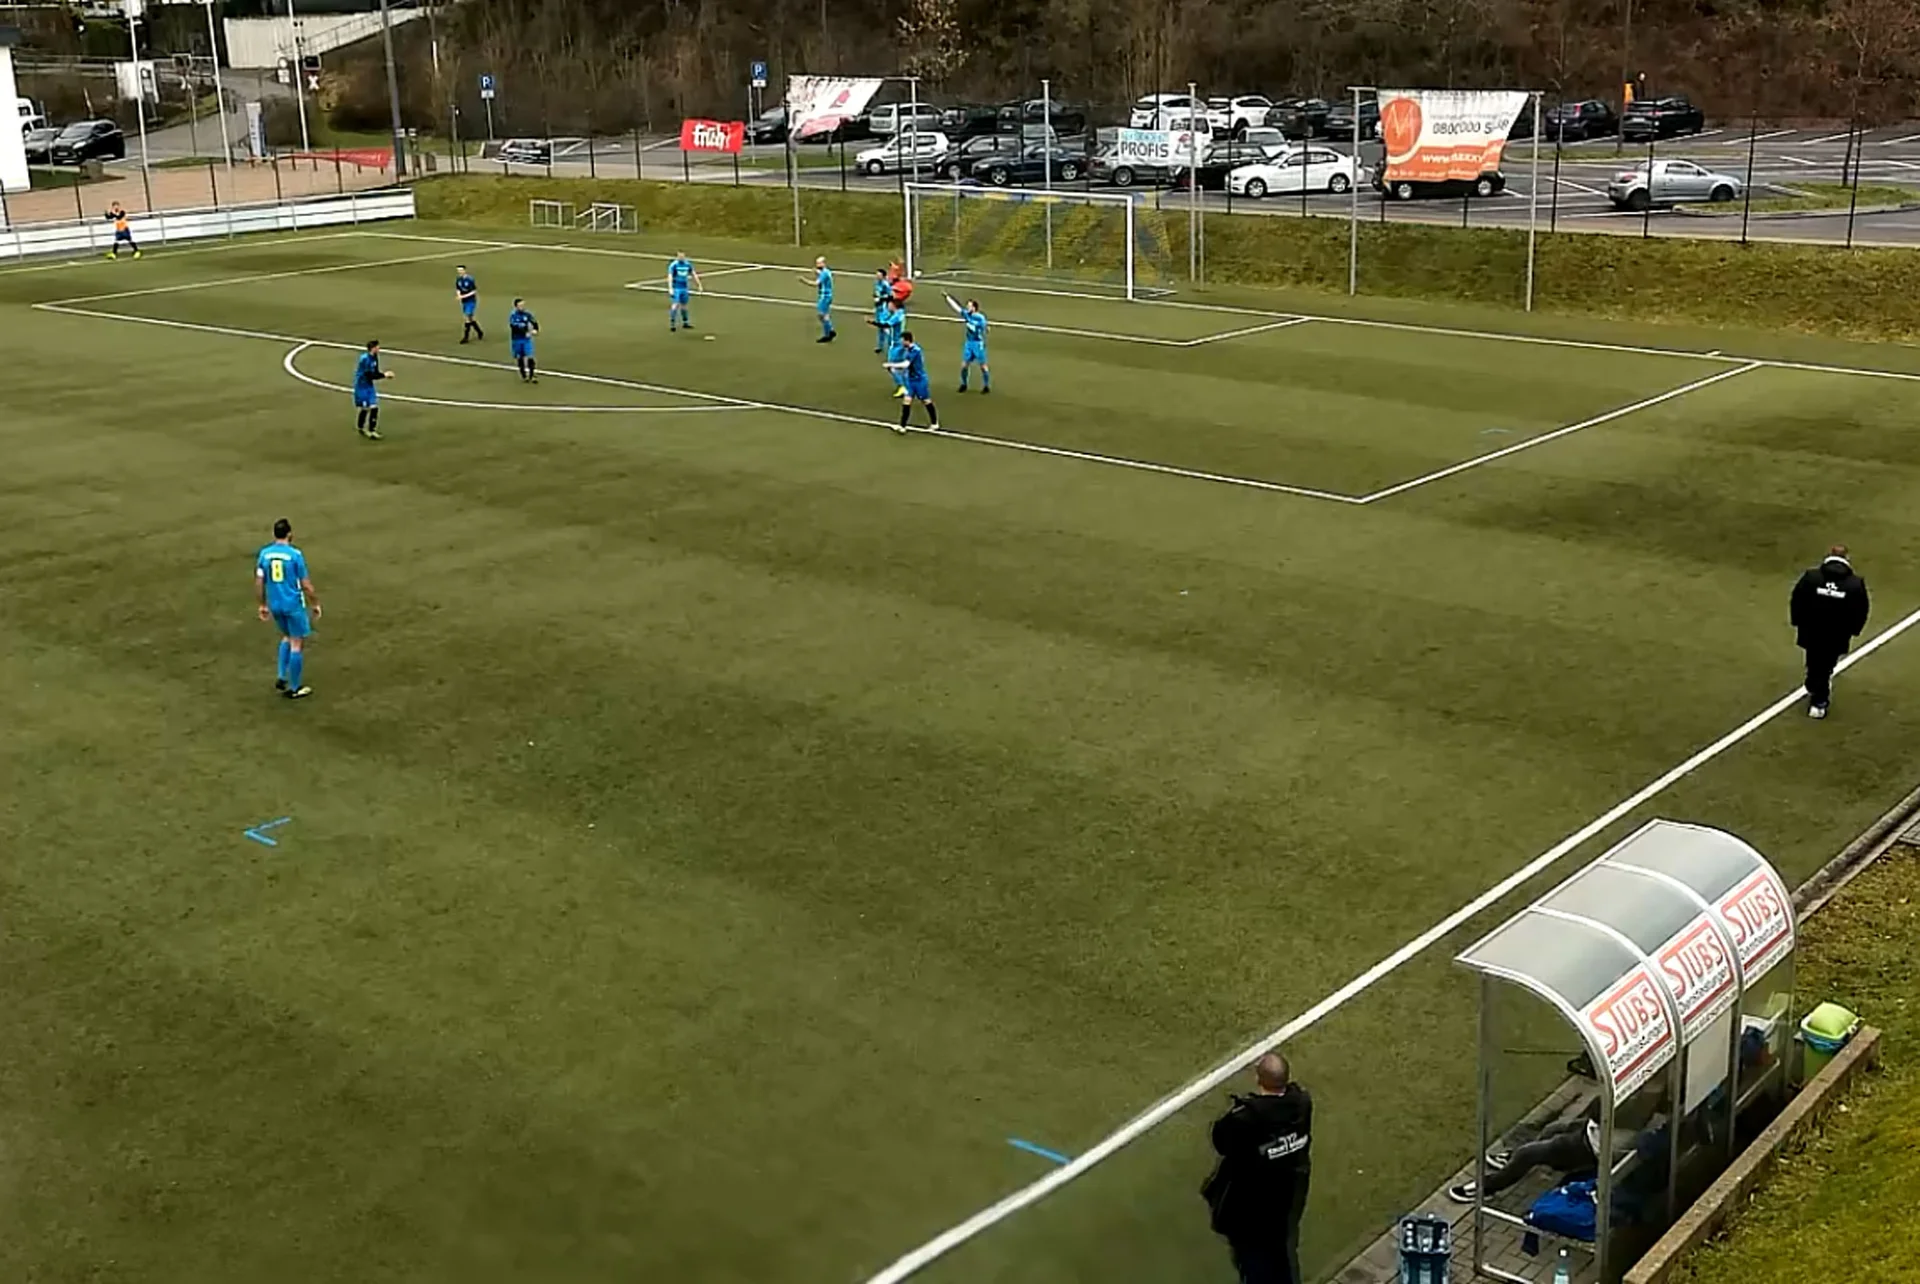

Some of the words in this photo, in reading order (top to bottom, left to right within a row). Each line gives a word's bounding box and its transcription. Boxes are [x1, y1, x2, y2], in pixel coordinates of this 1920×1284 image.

[755, 64, 763, 76] P
[482, 77, 492, 88] P
[1120, 141, 1169, 157] PROFIS
[271, 560, 284, 582] 8
[1721, 886, 1780, 947] STUBS
[1659, 934, 1723, 1000] STUBS
[1590, 985, 1659, 1057] STUBS
